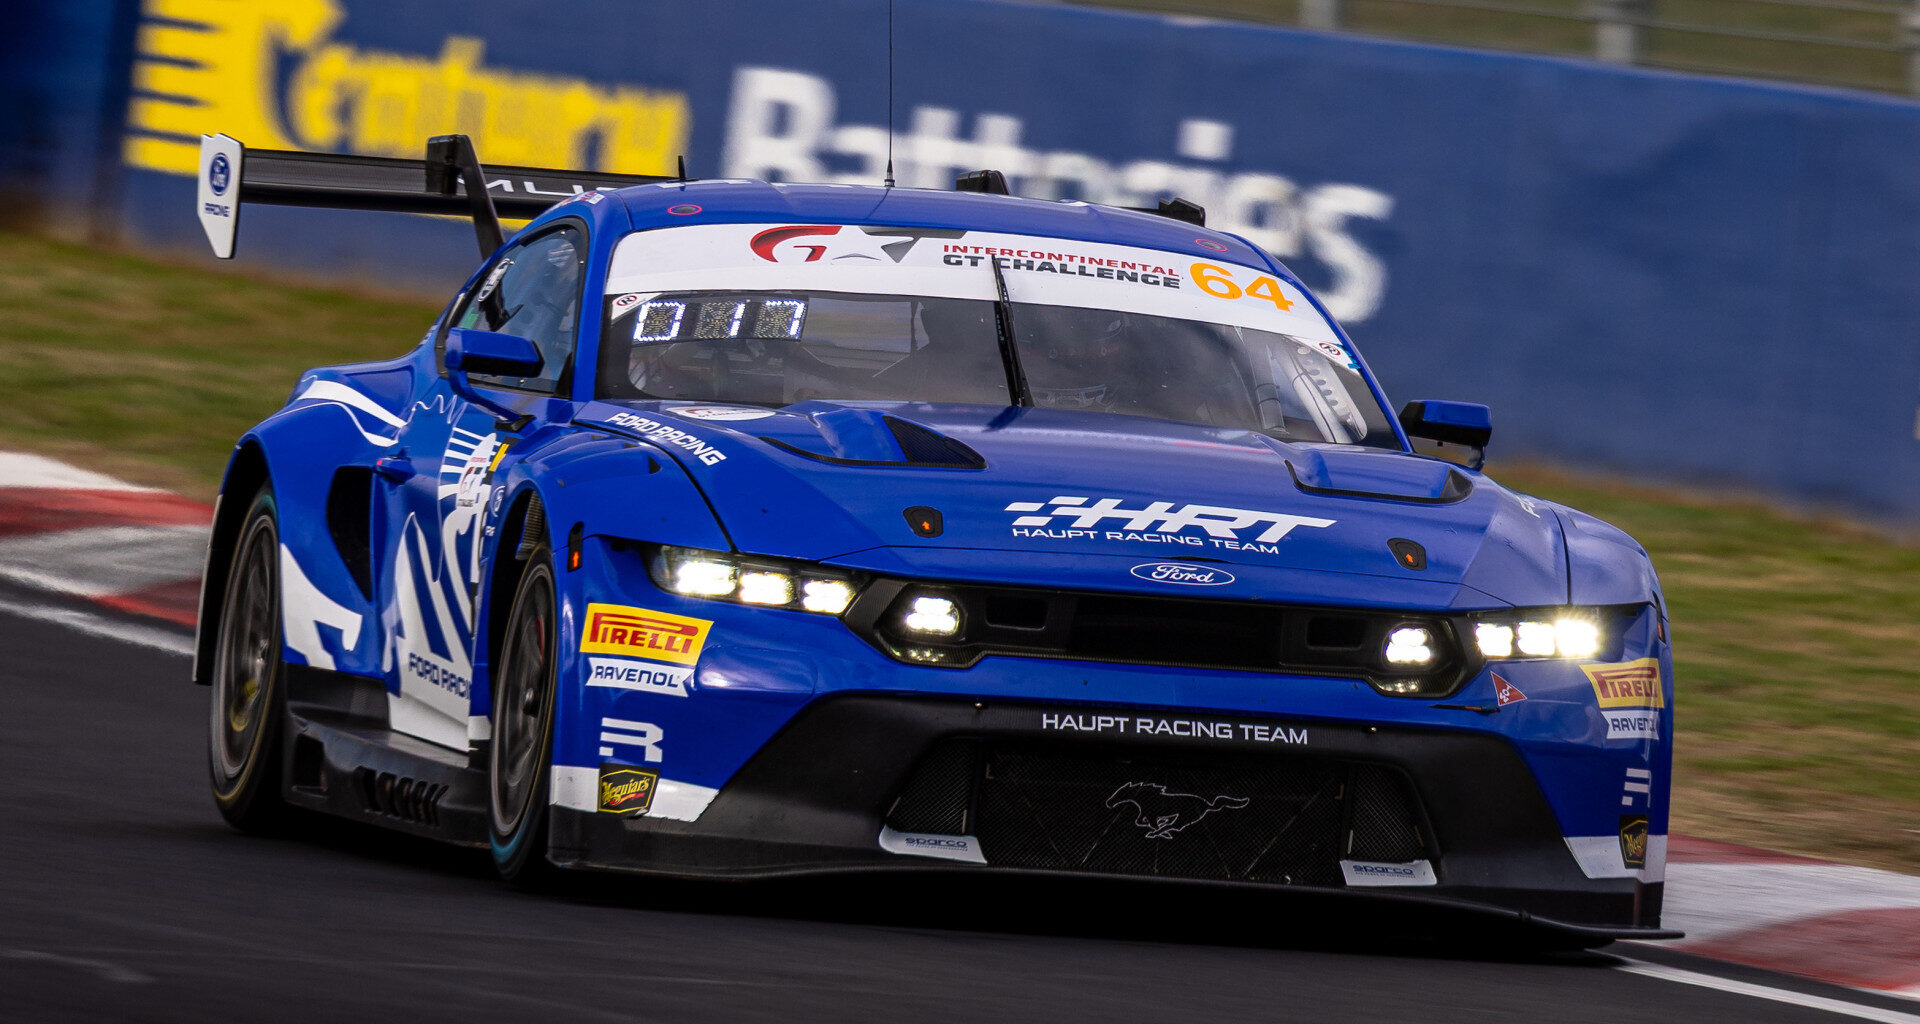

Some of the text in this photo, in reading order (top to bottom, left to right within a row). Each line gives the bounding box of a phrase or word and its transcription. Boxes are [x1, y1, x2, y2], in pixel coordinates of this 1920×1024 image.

[943, 244, 1180, 277] INTERCONTINENTAL
[943, 254, 1181, 290] GT CHALLENGE
[1190, 262, 1294, 312] 64
[633, 301, 805, 341] 017
[604, 412, 727, 466] FORD RACING
[1051, 496, 1337, 543] HRT
[1012, 528, 1280, 555] HAUPT RACING TEAM
[1151, 564, 1215, 584] Ford
[589, 612, 699, 654] PIRELLI
[408, 652, 440, 686] FORD
[594, 665, 679, 688] RAVENOL
[1042, 714, 1308, 745] HAUPT RACING TEAM
[904, 837, 968, 849] sparco
[1353, 864, 1415, 876] sparco
